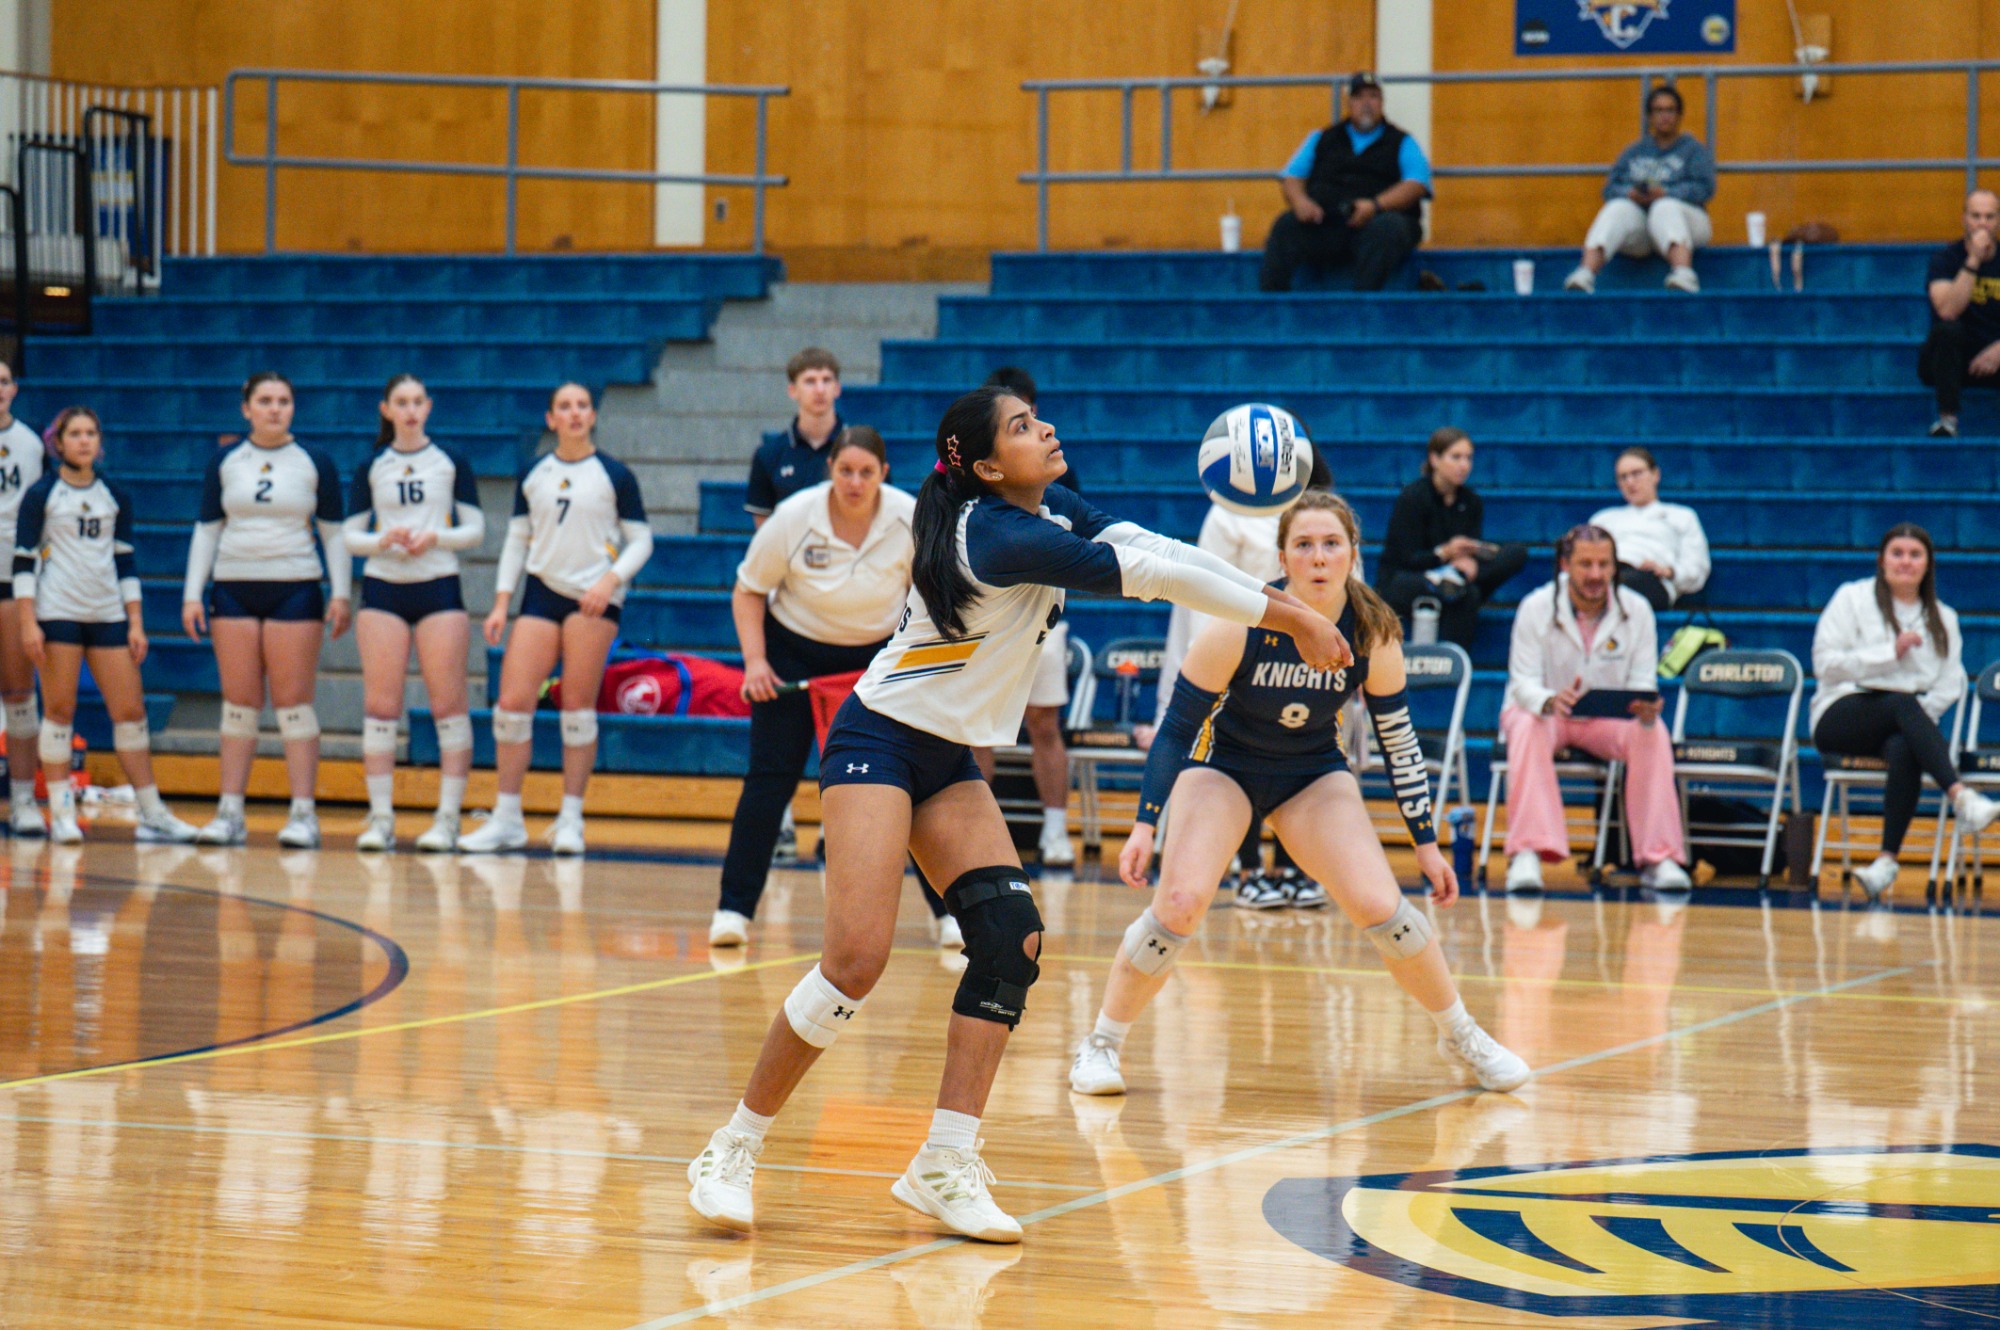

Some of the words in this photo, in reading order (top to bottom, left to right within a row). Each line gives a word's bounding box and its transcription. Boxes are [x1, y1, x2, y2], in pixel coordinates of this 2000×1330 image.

[255, 480, 273, 502] 2
[397, 480, 423, 505] 16
[556, 498, 570, 524] 7
[77, 516, 101, 539] 18
[1699, 663, 1784, 682] CARLETON
[1375, 706, 1430, 818] KNIGHTS
